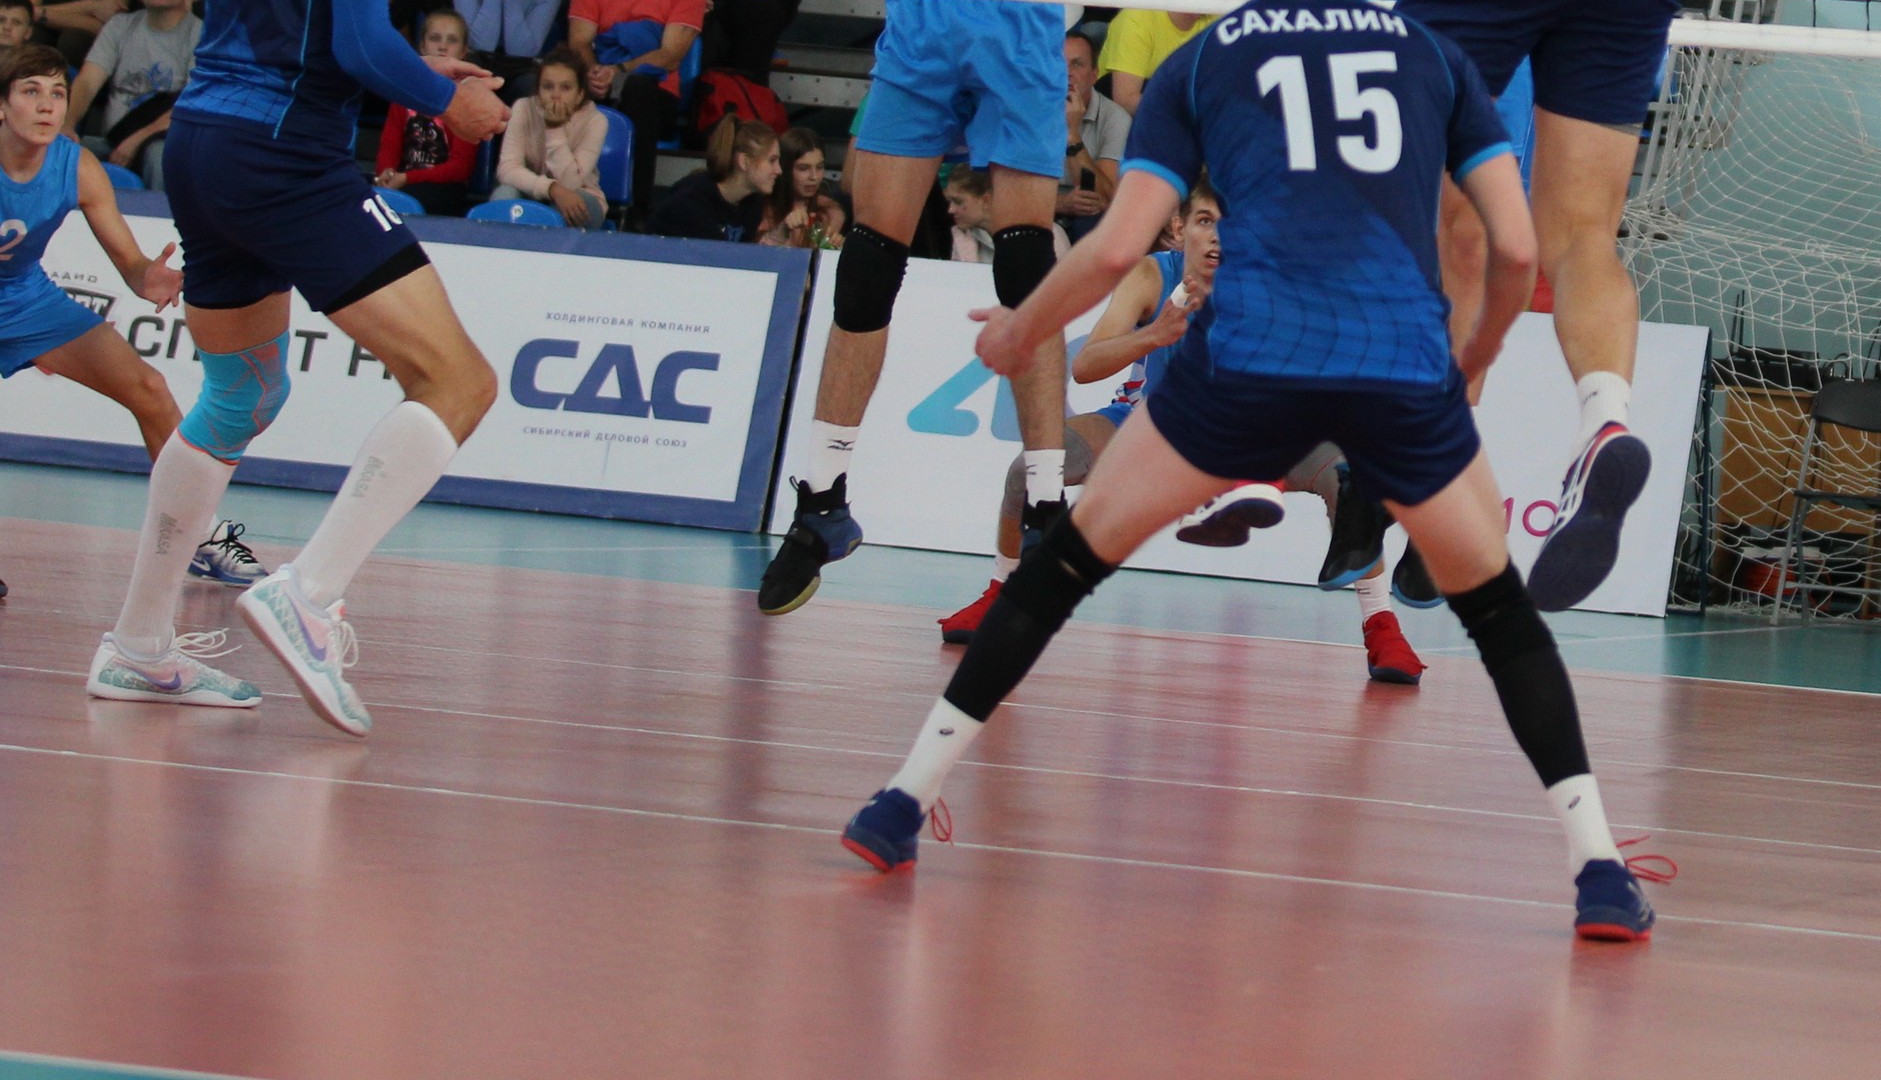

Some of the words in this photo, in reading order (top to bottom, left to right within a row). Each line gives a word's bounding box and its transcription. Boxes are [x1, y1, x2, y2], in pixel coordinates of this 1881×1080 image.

[1216, 8, 1408, 46] САХАЛИН
[1256, 50, 1403, 174] 15
[546, 311, 634, 327] ХОЛДИНГОВАЯ
[641, 320, 711, 334] КОМПАНИЯ
[523, 425, 591, 439] СИБИРСКИЙ
[596, 431, 649, 445] ДЕЛОВОЙ
[655, 437, 687, 448] СОЮЗ
